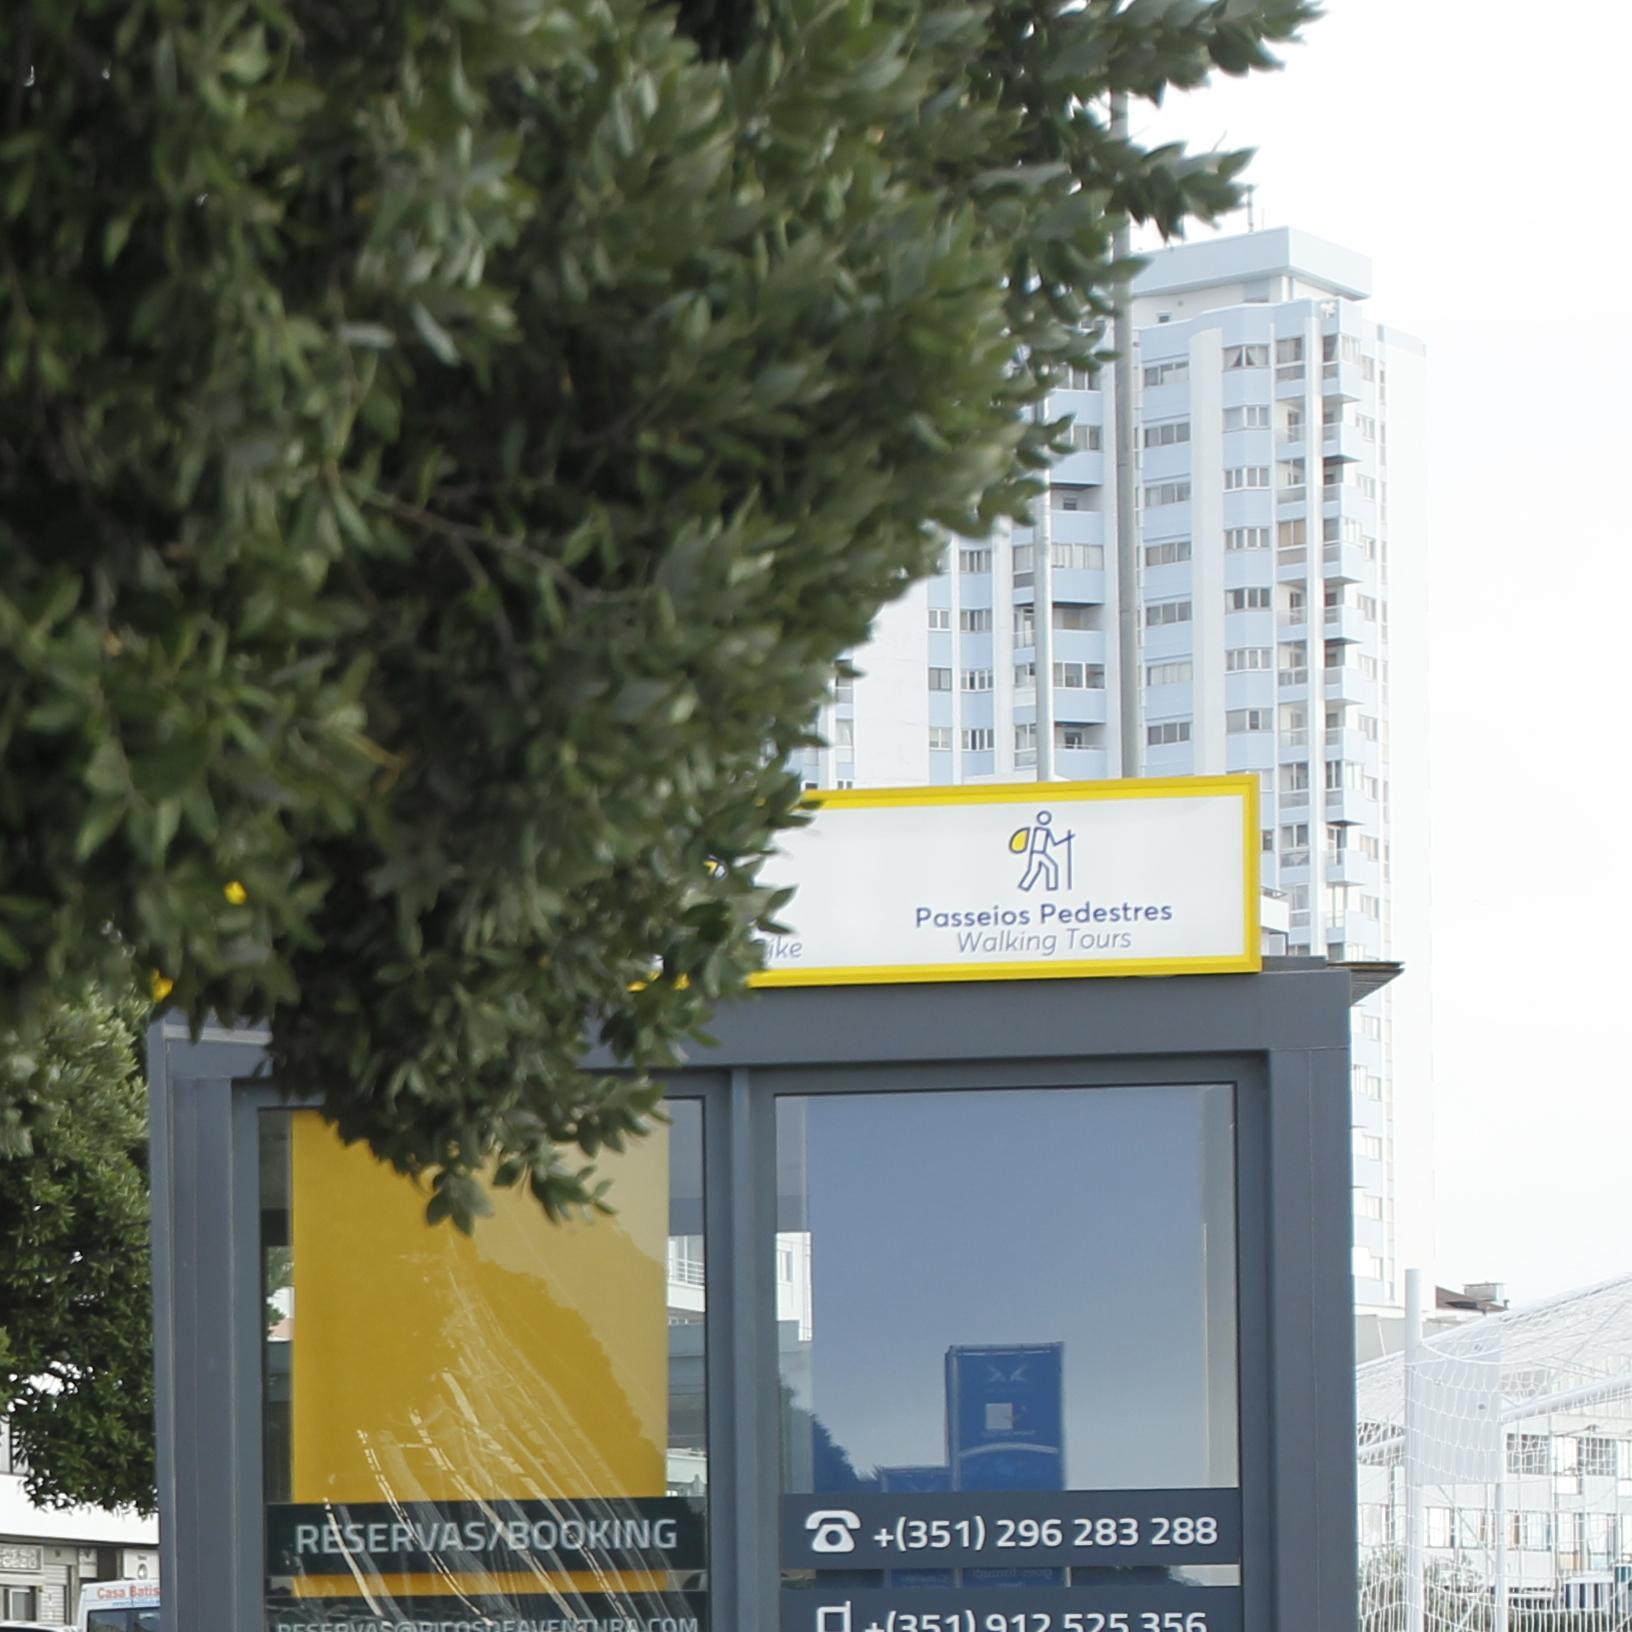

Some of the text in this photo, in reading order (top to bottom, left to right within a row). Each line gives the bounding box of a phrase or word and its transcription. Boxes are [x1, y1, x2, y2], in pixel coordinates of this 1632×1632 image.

[915, 901, 1173, 928] Passeios Pedestres
[767, 936, 803, 959] ike
[957, 927, 1132, 956] Walking Tours
[295, 1518, 679, 1555] RESERVAS/BOOKING
[873, 1515, 1219, 1552] +(351) 296 283 288
[97, 1584, 160, 1599] Casa Batis
